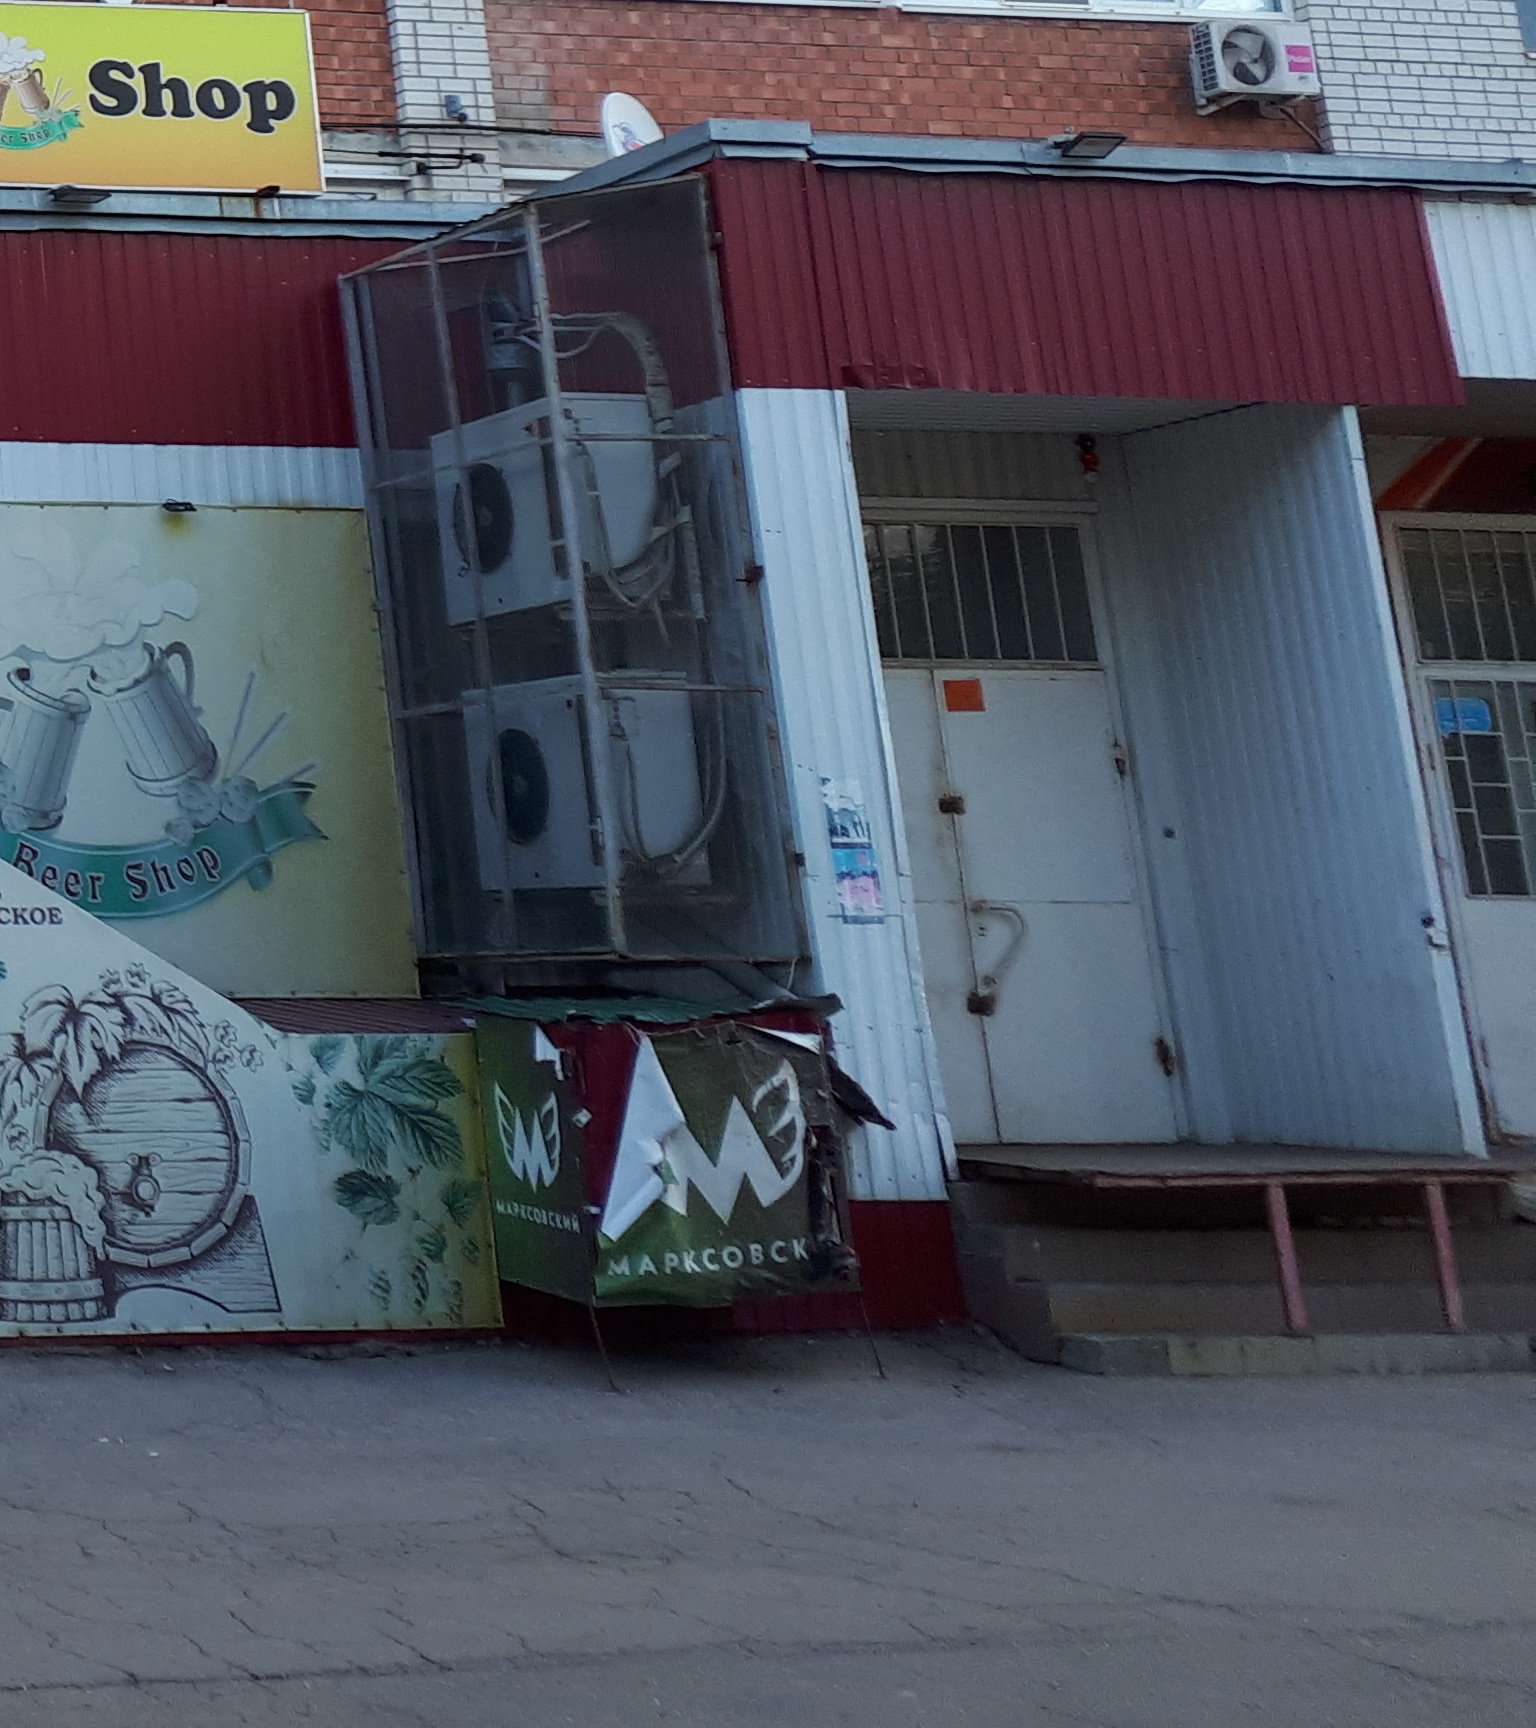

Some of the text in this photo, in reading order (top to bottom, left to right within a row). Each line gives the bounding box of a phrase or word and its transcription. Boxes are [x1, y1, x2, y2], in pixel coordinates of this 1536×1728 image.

[87, 58, 296, 134] Shop
[20, 128, 50, 143] Shop
[12, 841, 221, 903] Beer Shop
[496, 1199, 581, 1234] МАРКСОВСКИЙ
